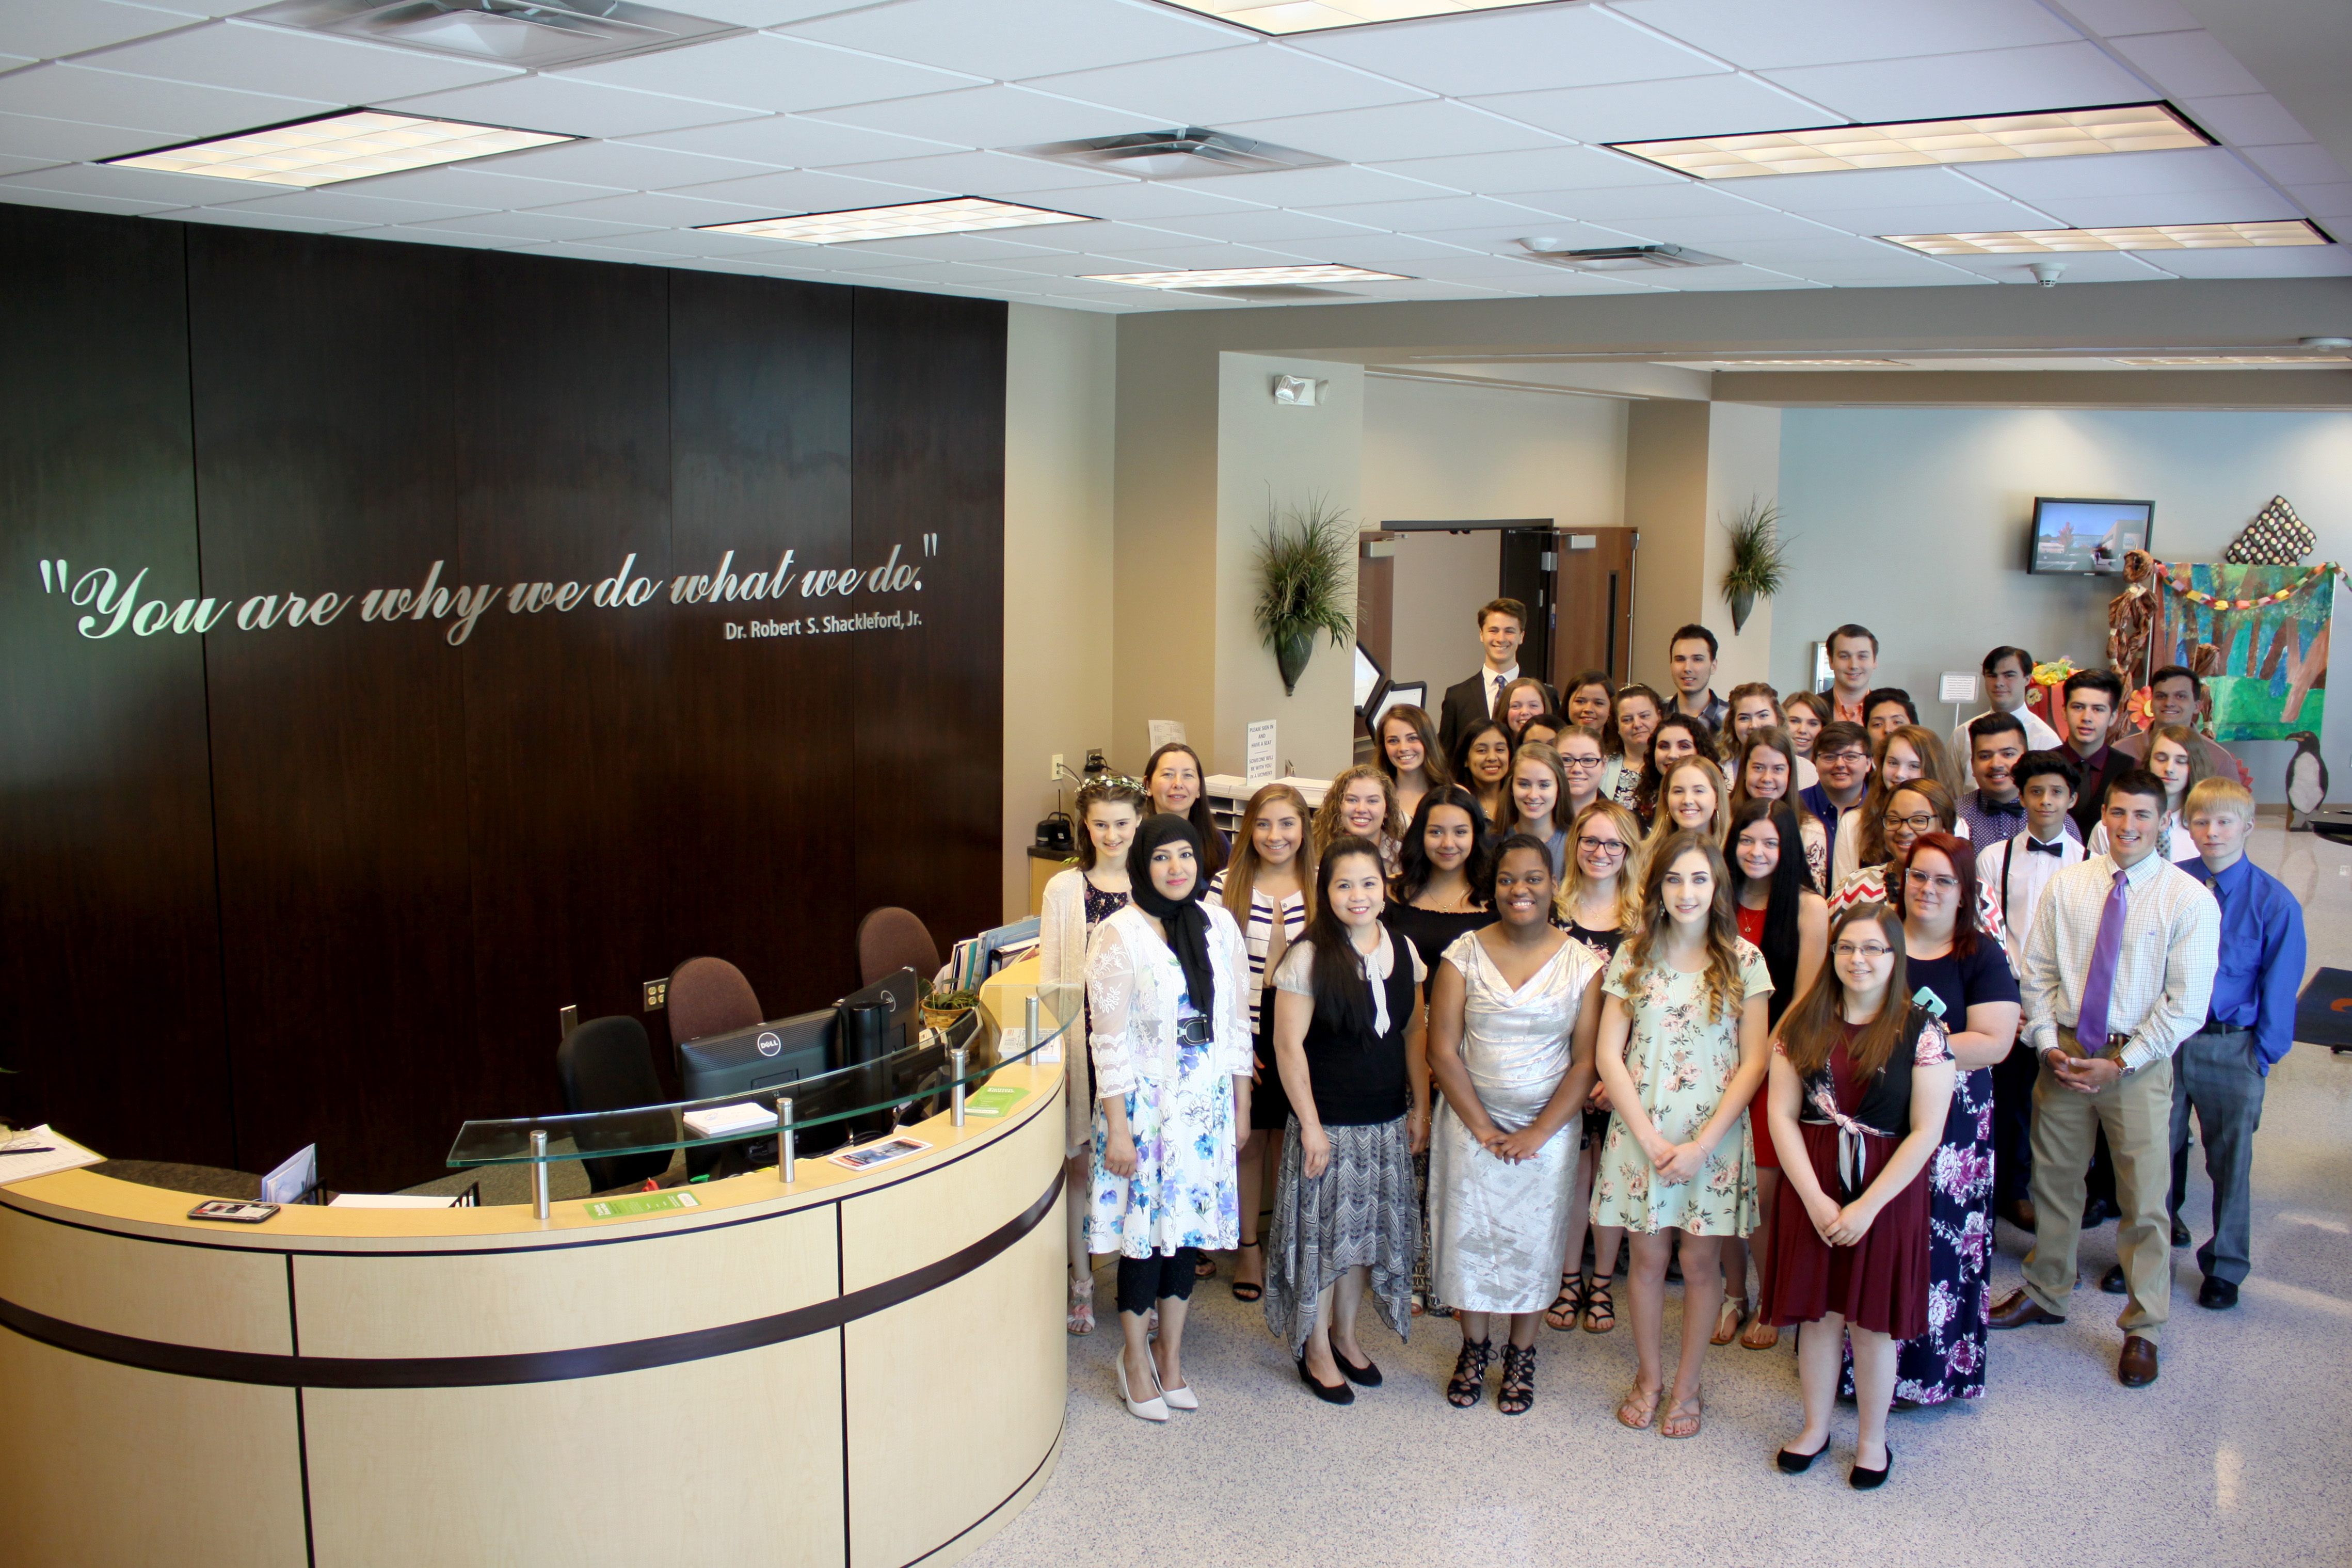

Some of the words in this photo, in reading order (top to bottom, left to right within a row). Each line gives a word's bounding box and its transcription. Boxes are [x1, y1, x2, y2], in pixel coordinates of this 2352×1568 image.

[236, 591, 354, 631] are
[361, 559, 503, 646] why
[507, 581, 592, 614] we
[593, 553, 664, 607] do
[670, 549, 796, 604] what
[801, 568, 867, 598] we
[725, 622, 747, 640] Dr.
[750, 619, 801, 638] Robert
[806, 617, 820, 634] S.
[822, 610, 905, 633] Shackleford,
[906, 610, 922, 627] Jr.
[760, 1039, 778, 1049] DELL
